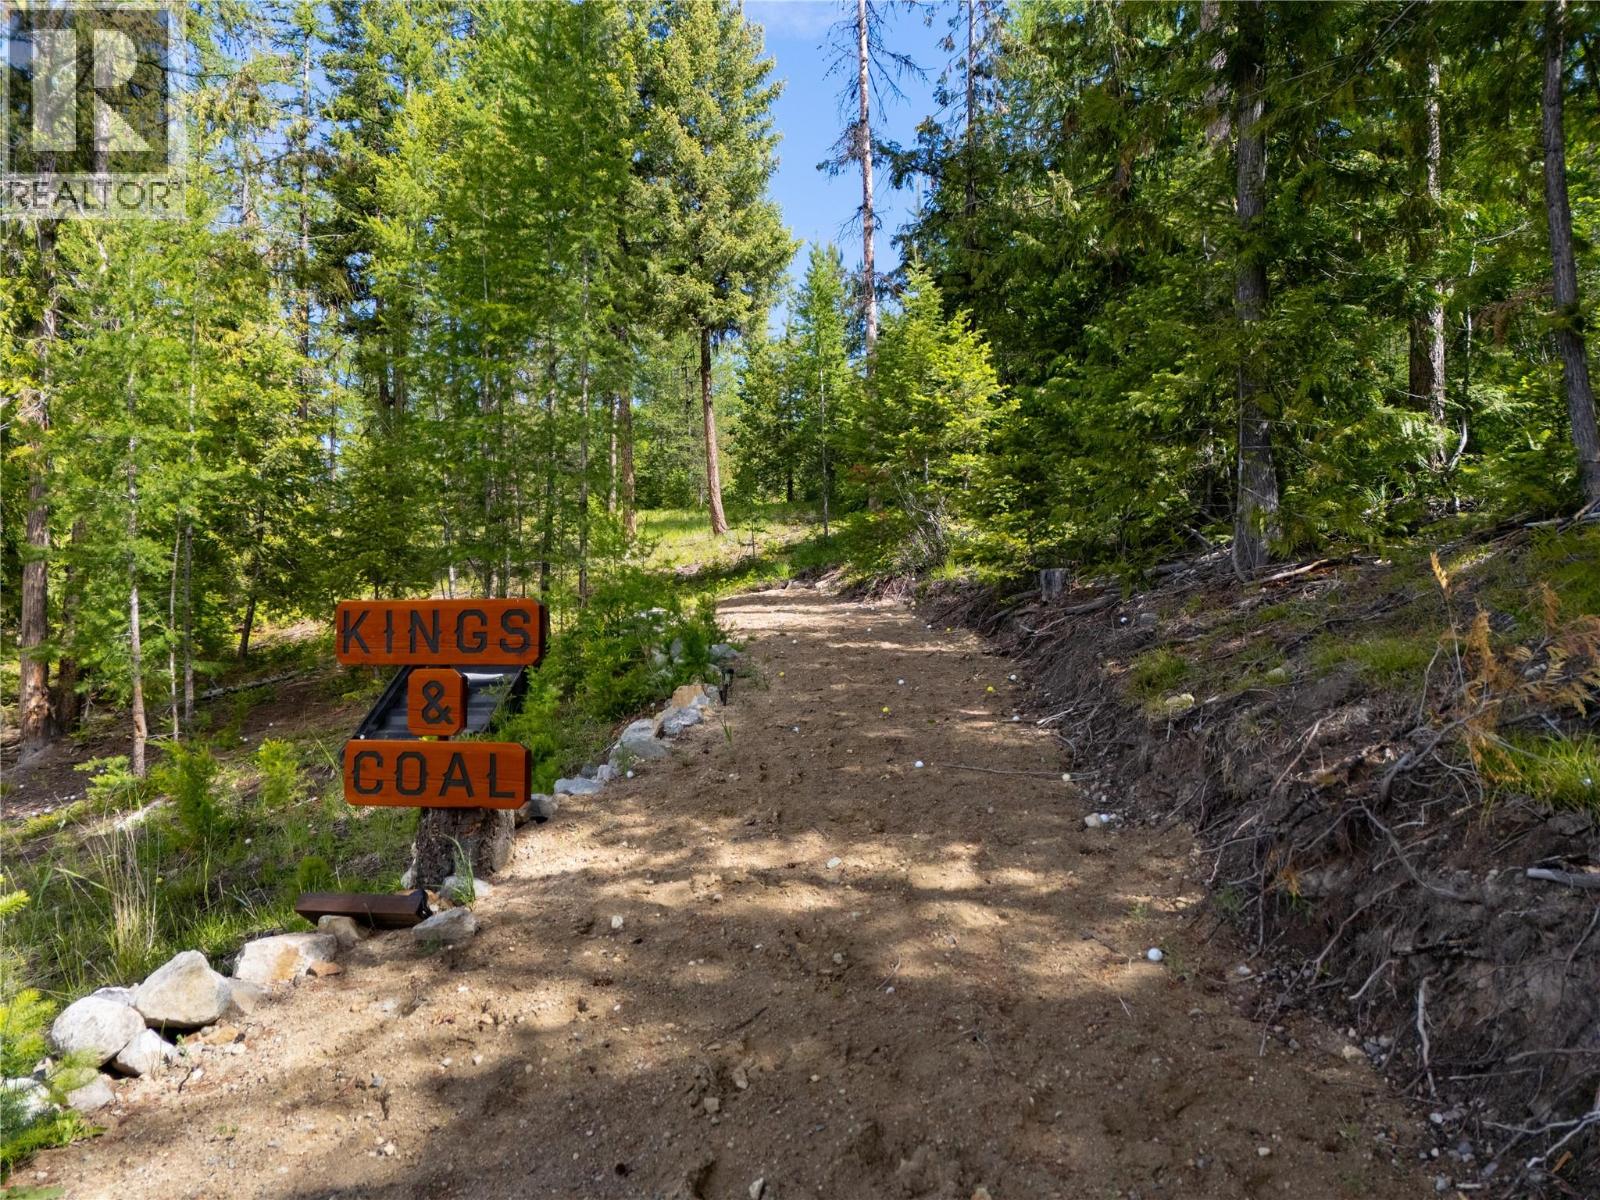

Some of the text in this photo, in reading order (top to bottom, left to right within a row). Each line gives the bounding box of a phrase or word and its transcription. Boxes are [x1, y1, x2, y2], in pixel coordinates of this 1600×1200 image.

[341, 609, 531, 655] KINGS
[420, 680, 454, 725] &
[352, 750, 515, 798] COAL
